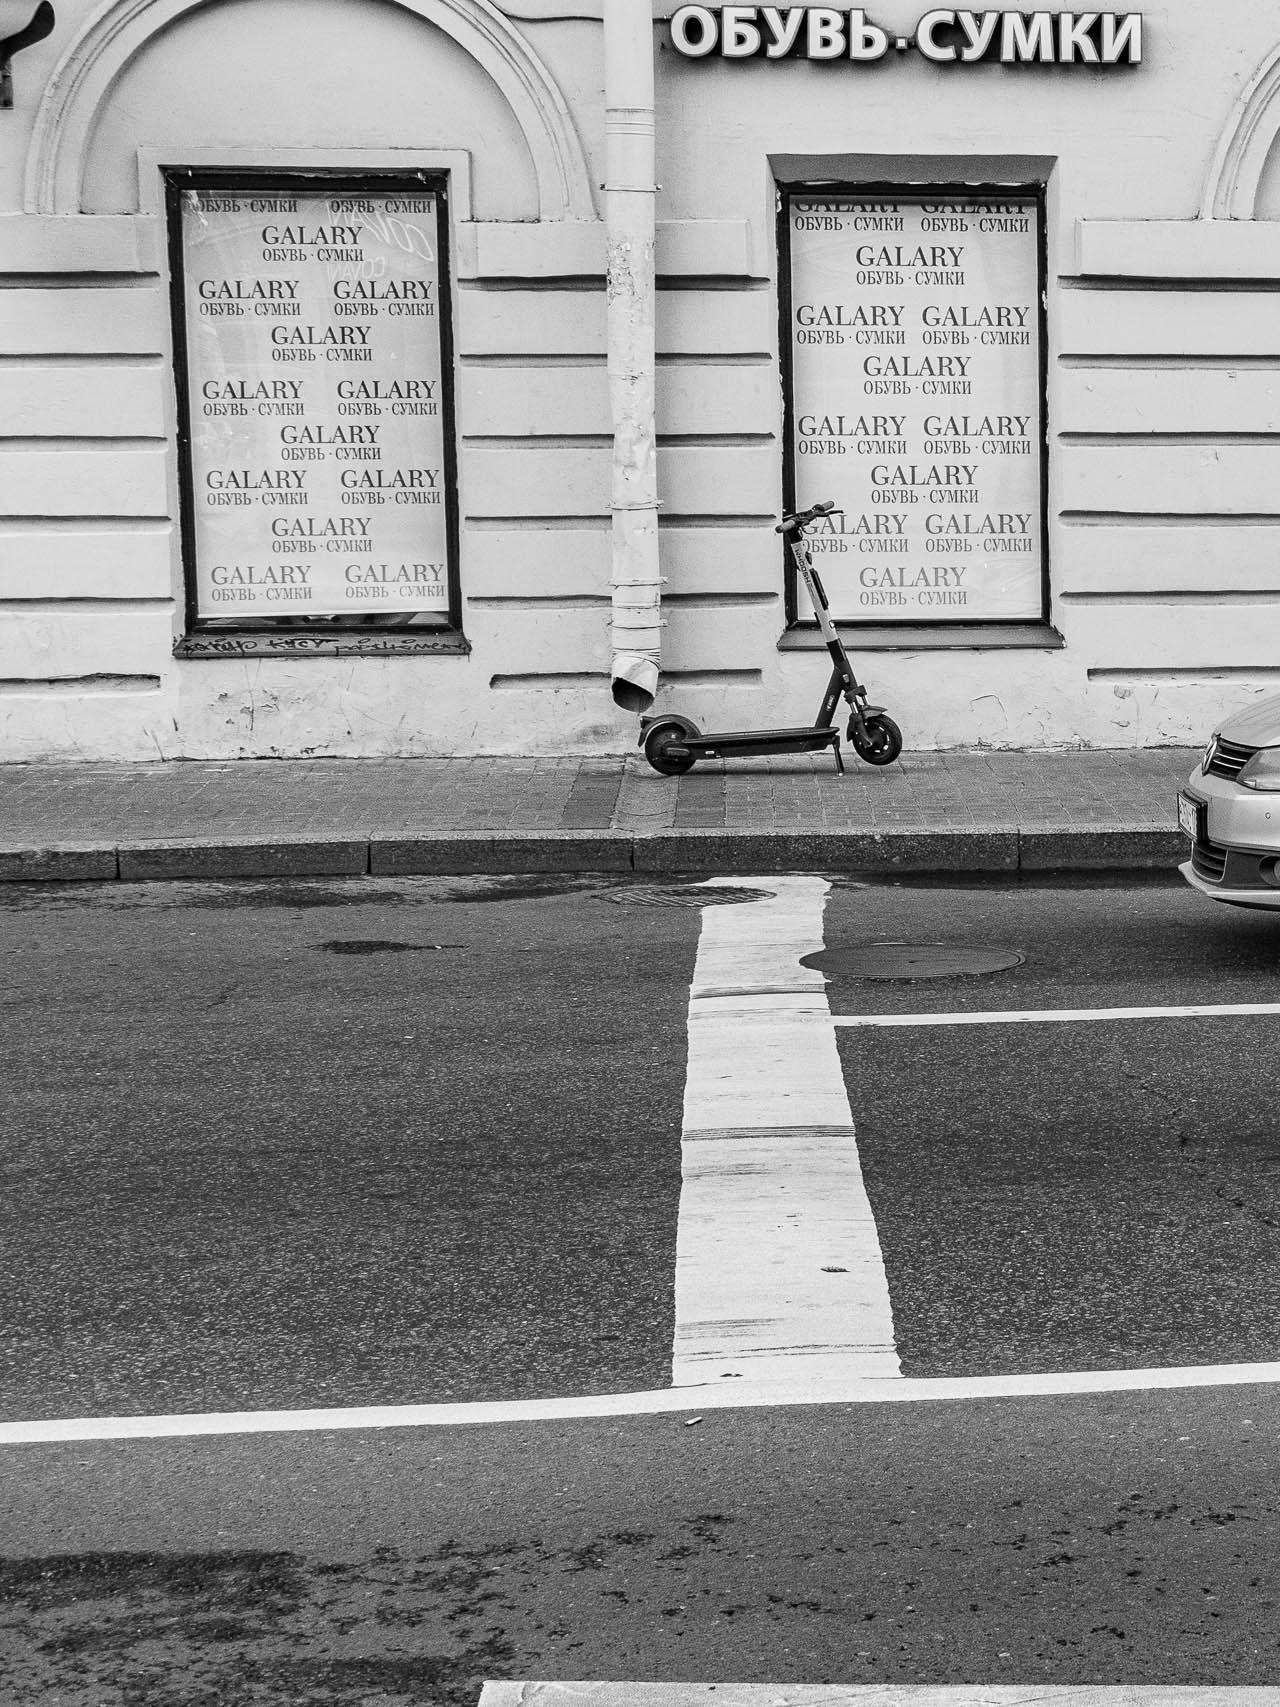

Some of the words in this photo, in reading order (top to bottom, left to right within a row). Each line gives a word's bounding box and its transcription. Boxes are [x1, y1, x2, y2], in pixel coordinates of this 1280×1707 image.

[384, 200, 431, 213] СУМКИ
[795, 217, 842, 231] ОБУВЬ
[854, 217, 904, 231] СУМКИ
[921, 217, 968, 232] ОБУВЬ
[980, 218, 1029, 232] СУМКИ
[262, 226, 363, 245] GALARY
[263, 249, 307, 261] ОБУВЬ
[317, 249, 363, 261] СУМКИ
[856, 246, 964, 267] GALARY
[857, 271, 903, 285] ОБУВЬ
[916, 271, 964, 285] СУМКИ
[199, 280, 299, 299] GALARY
[334, 280, 432, 299] GALARY
[200, 303, 244, 316] ОБУВЬ
[255, 303, 300, 316] СУМКИ
[334, 303, 378, 315] ОБУВЬ
[389, 303, 434, 316] СУМКИ
[796, 305, 904, 326] GALARY
[922, 306, 1030, 327] GALARY
[272, 326, 371, 344] GALARY
[797, 330, 844, 344] ОБУВЬ
[856, 330, 905, 344] СУМКИ
[923, 331, 969, 344] ОБУВЬ
[981, 331, 1030, 344] СУМКИ
[272, 349, 316, 361] ОБУВЬ
[327, 349, 372, 361] СУМКИ
[864, 356, 971, 376] GALARY
[203, 381, 303, 399] GALARY
[338, 380, 436, 399] GALARY
[864, 381, 911, 394] ОБУВЬ
[923, 381, 971, 394] СУМКИ
[203, 403, 247, 416] ОБУВЬ
[258, 403, 304, 415] СУМКИ
[338, 403, 381, 415] ОБУВЬ
[392, 403, 437, 415] СУМКИ
[798, 416, 906, 436] GALARY
[924, 416, 1031, 436] GALARY
[281, 425, 380, 444] GALARY
[281, 448, 325, 460] ОБУВЬ
[336, 448, 381, 460] СУМКИ
[799, 440, 845, 454] ОБУВЬ
[858, 440, 906, 454] СУМКИ
[924, 441, 970, 454] ОБУВЬ
[982, 441, 1031, 454] СУМКИ
[207, 470, 306, 489] GALARY
[341, 470, 439, 488] GALARY
[871, 465, 978, 485] GALARY
[207, 493, 251, 505] ОБУВЬ
[262, 492, 308, 505] СУМКИ
[342, 492, 385, 504] ОБУВЬ
[395, 492, 440, 504] СУМКИ
[871, 490, 918, 503] ОБУВЬ
[930, 490, 978, 503] СУМКИ
[272, 518, 372, 536] GALARY
[926, 514, 1032, 534] GALARY
[272, 540, 316, 553] ОБУВЬ
[327, 540, 372, 552] СУМКИ
[859, 539, 908, 552] СУМКИ
[926, 538, 972, 552] ОБУВЬ
[984, 538, 1032, 552] СУМКИ
[211, 566, 311, 585] GALARY
[345, 564, 444, 583] GALARY
[860, 567, 966, 587] GALARY
[212, 588, 256, 601] ОБУВЬ
[266, 587, 312, 600] СУМКИ
[346, 586, 389, 598] ОБУВЬ
[400, 586, 446, 599] СУМКИ
[860, 590, 907, 605] ОБУВЬ
[918, 591, 967, 605] СУМКИ
